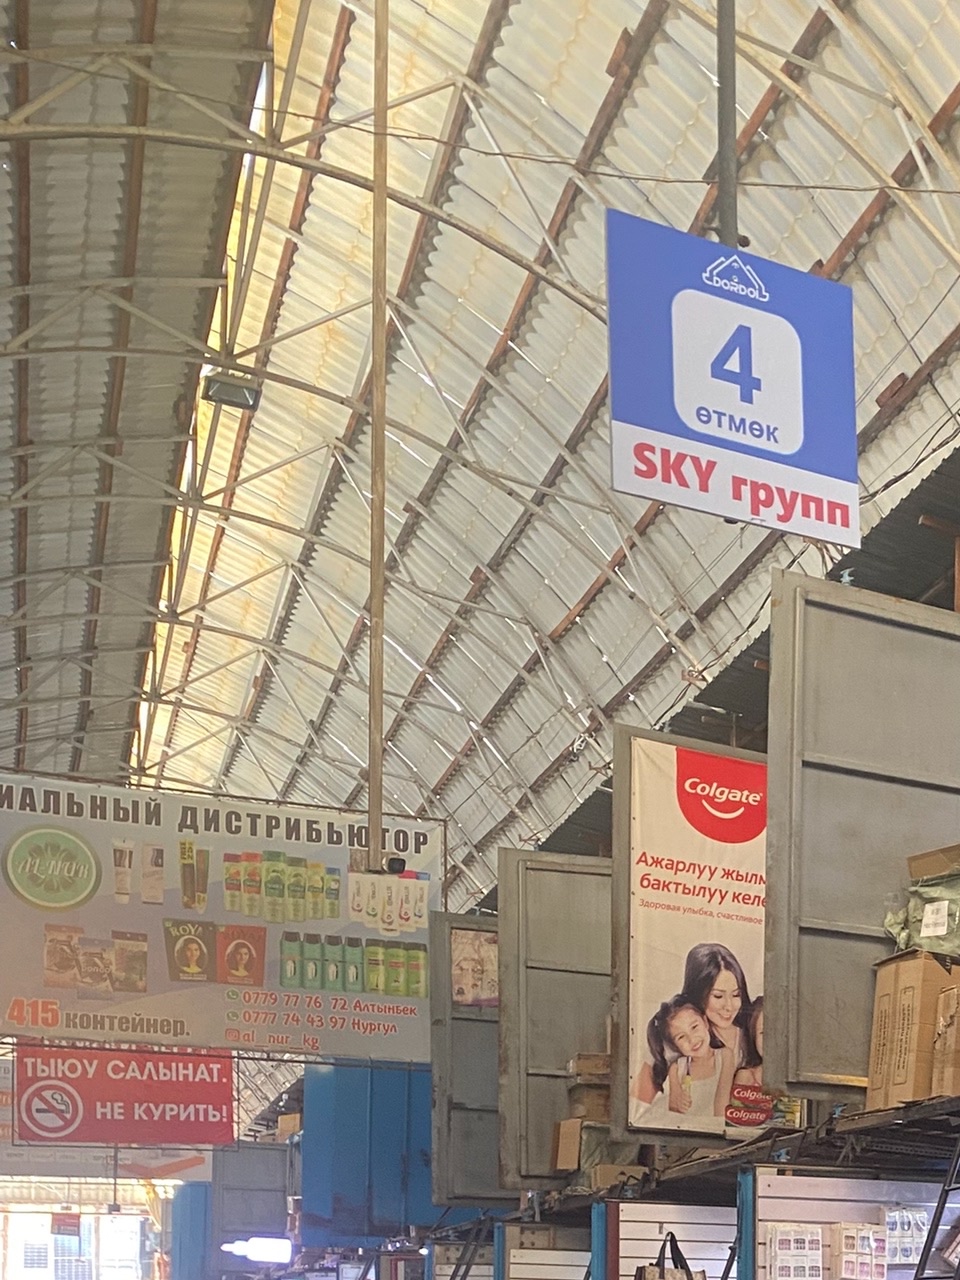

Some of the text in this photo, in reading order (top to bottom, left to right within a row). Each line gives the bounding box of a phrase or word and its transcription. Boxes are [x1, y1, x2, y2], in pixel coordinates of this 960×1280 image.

[710, 324, 762, 405] 4
[695, 406, 779, 444] ӨТМӨК
[633, 442, 850, 528] SKY групп
[684, 777, 761, 806] Colgate
[636, 851, 718, 881] Ажарлуу
[639, 873, 729, 905] бактылуу
[638, 898, 763, 925] Здоровая улыбка, счастливое
[243, 991, 278, 1006] 0779
[283, 993, 300, 1007] 77
[305, 995, 322, 1009] 76
[331, 997, 348, 1011] 72
[7, 996, 190, 1038] 415 контейнер.
[243, 1011, 277, 1025] 0777
[282, 1013, 300, 1027] 74
[306, 1014, 324, 1029] 43
[329, 1016, 346, 1030] 97
[23, 1057, 98, 1079] ТЫЮУ
[106, 1060, 227, 1083] САЛЫНАТ.
[96, 1102, 227, 1123] НЕ КУРИТЬ!
[726, 1108, 766, 1120] Colgate
